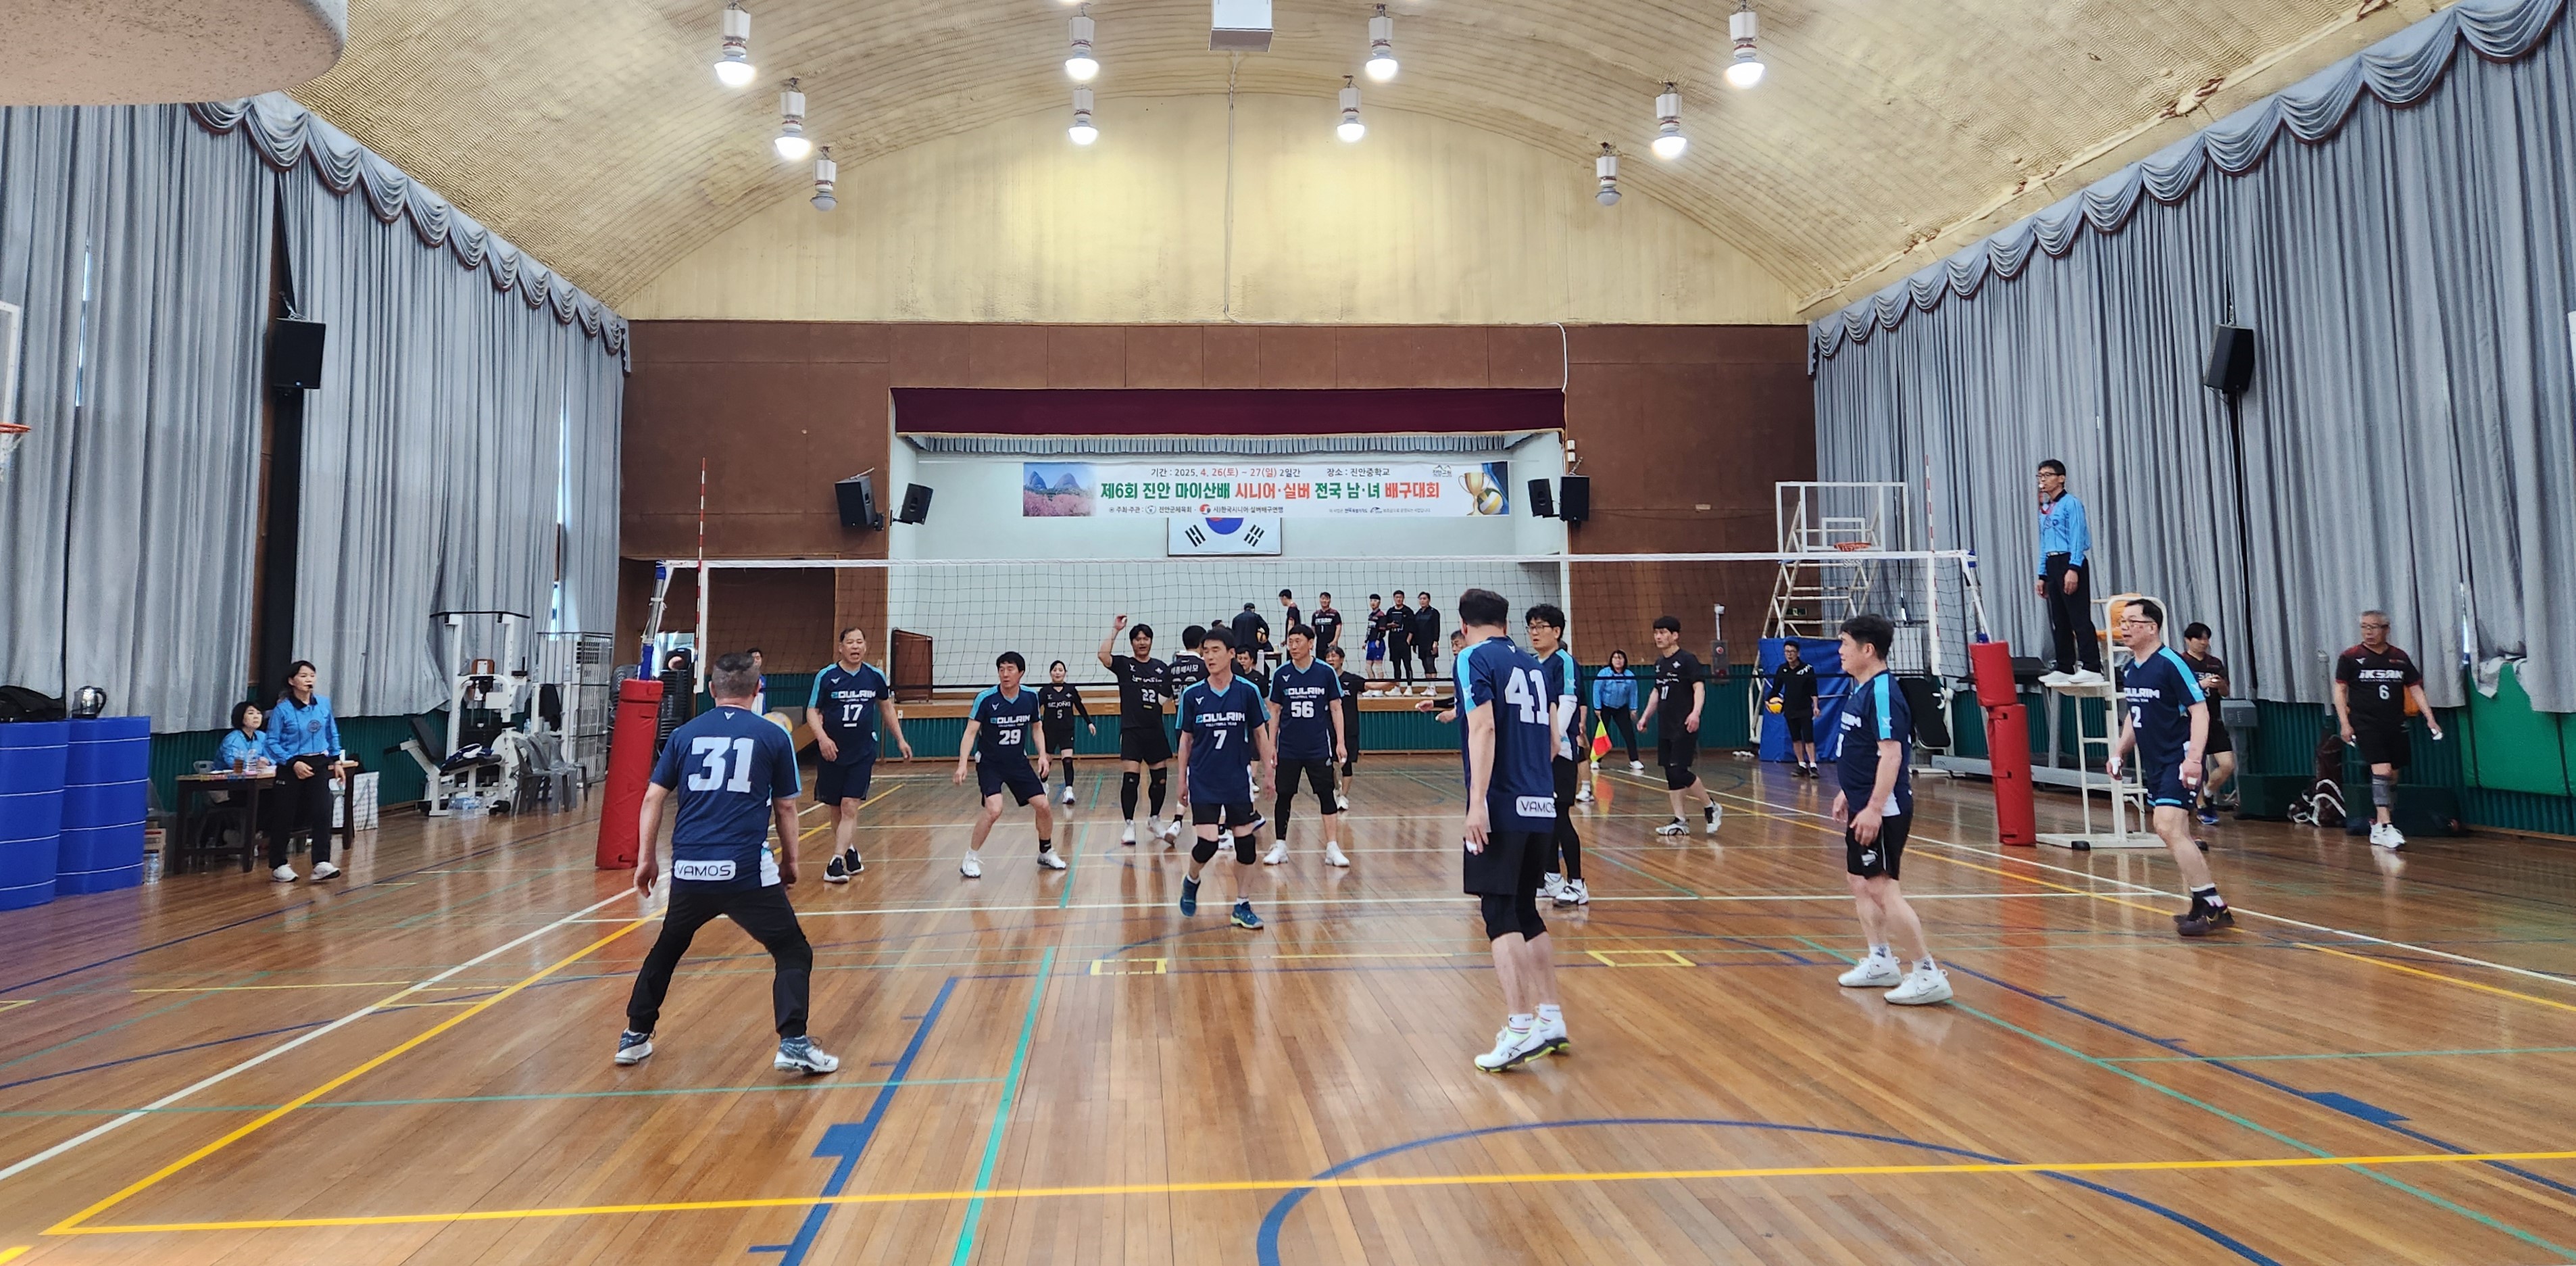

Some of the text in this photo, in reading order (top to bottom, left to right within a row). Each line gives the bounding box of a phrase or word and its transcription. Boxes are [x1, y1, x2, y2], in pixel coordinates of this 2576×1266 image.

[1151, 467, 1168, 477] 기간
[1174, 468, 1199, 477] 2025.
[1200, 468, 1209, 477] 4.
[1212, 467, 1239, 478] 26(토)
[1250, 468, 1277, 478] 27(일)
[1279, 468, 1301, 478] 2일간
[1327, 468, 1343, 477] 장소
[1350, 467, 1390, 477] 진안중학교
[1101, 482, 1439, 499] 제6회 진안 마이산배 시니어·실버 전국 남·녀 배구대회
[1141, 688, 1156, 703] 22
[1504, 666, 1550, 725] 41
[2379, 685, 2389, 700] 6
[842, 704, 864, 721] 17
[1057, 709, 1063, 719] 5
[1291, 701, 1314, 718] 56
[2131, 706, 2142, 728] 2
[999, 729, 1021, 745] 29
[1214, 730, 1227, 750] 7
[688, 737, 755, 793] 31
[677, 864, 731, 877] VAMOS
